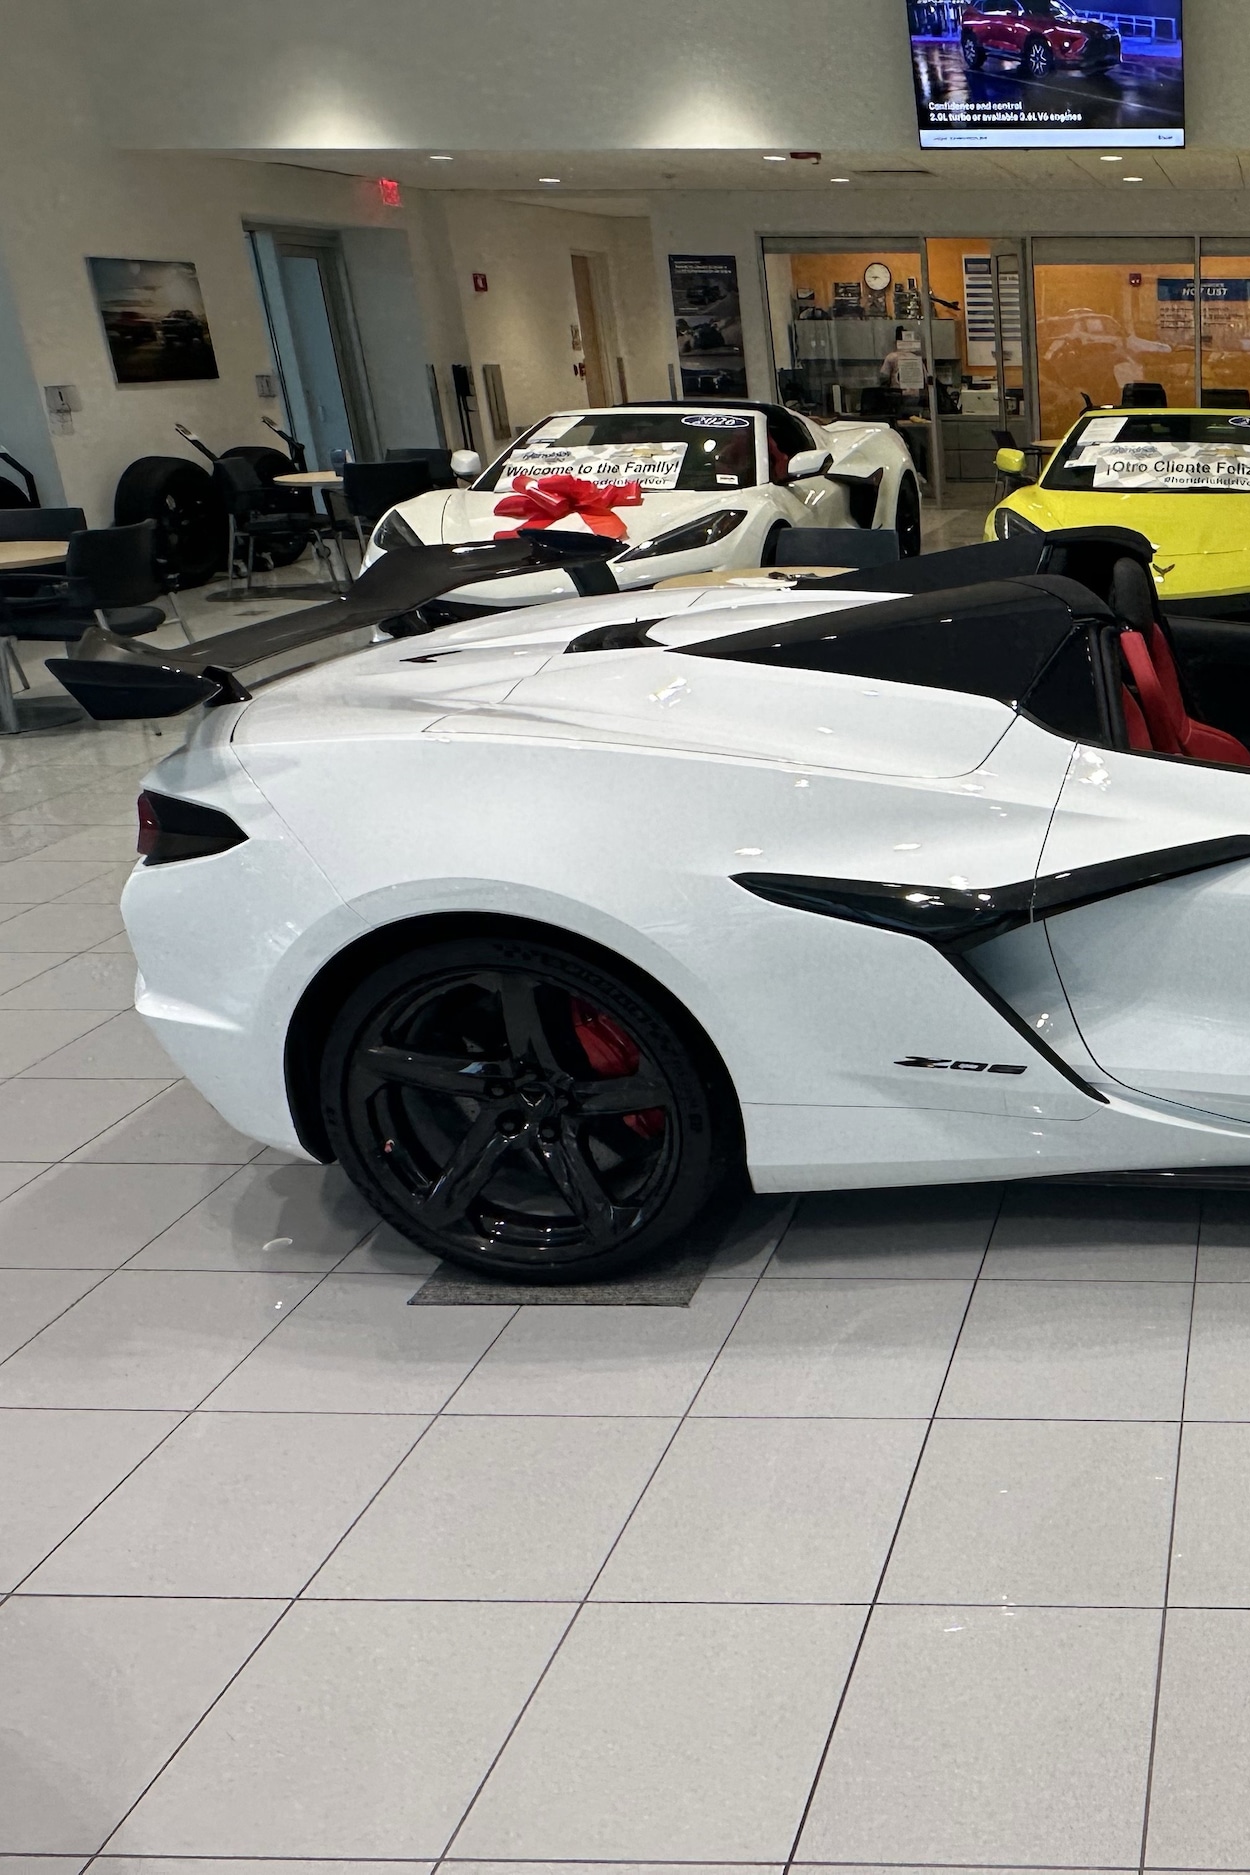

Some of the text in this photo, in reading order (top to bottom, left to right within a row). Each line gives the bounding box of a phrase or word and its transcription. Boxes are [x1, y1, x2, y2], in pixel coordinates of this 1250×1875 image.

[928, 101, 1022, 111] Confidence and control
[929, 112, 948, 122] 2.0L
[948, 112, 971, 122] turbo
[972, 113, 981, 122] or
[982, 112, 1019, 121] available
[1037, 112, 1049, 121] V6
[1049, 110, 1082, 123] engines
[1207, 287, 1228, 296] LIST
[507, 460, 679, 477] Welcome to the Family!
[1107, 461, 1148, 475] ¡Otro
[1154, 461, 1211, 474] Cliente
[894, 1056, 1028, 1075] Z06
